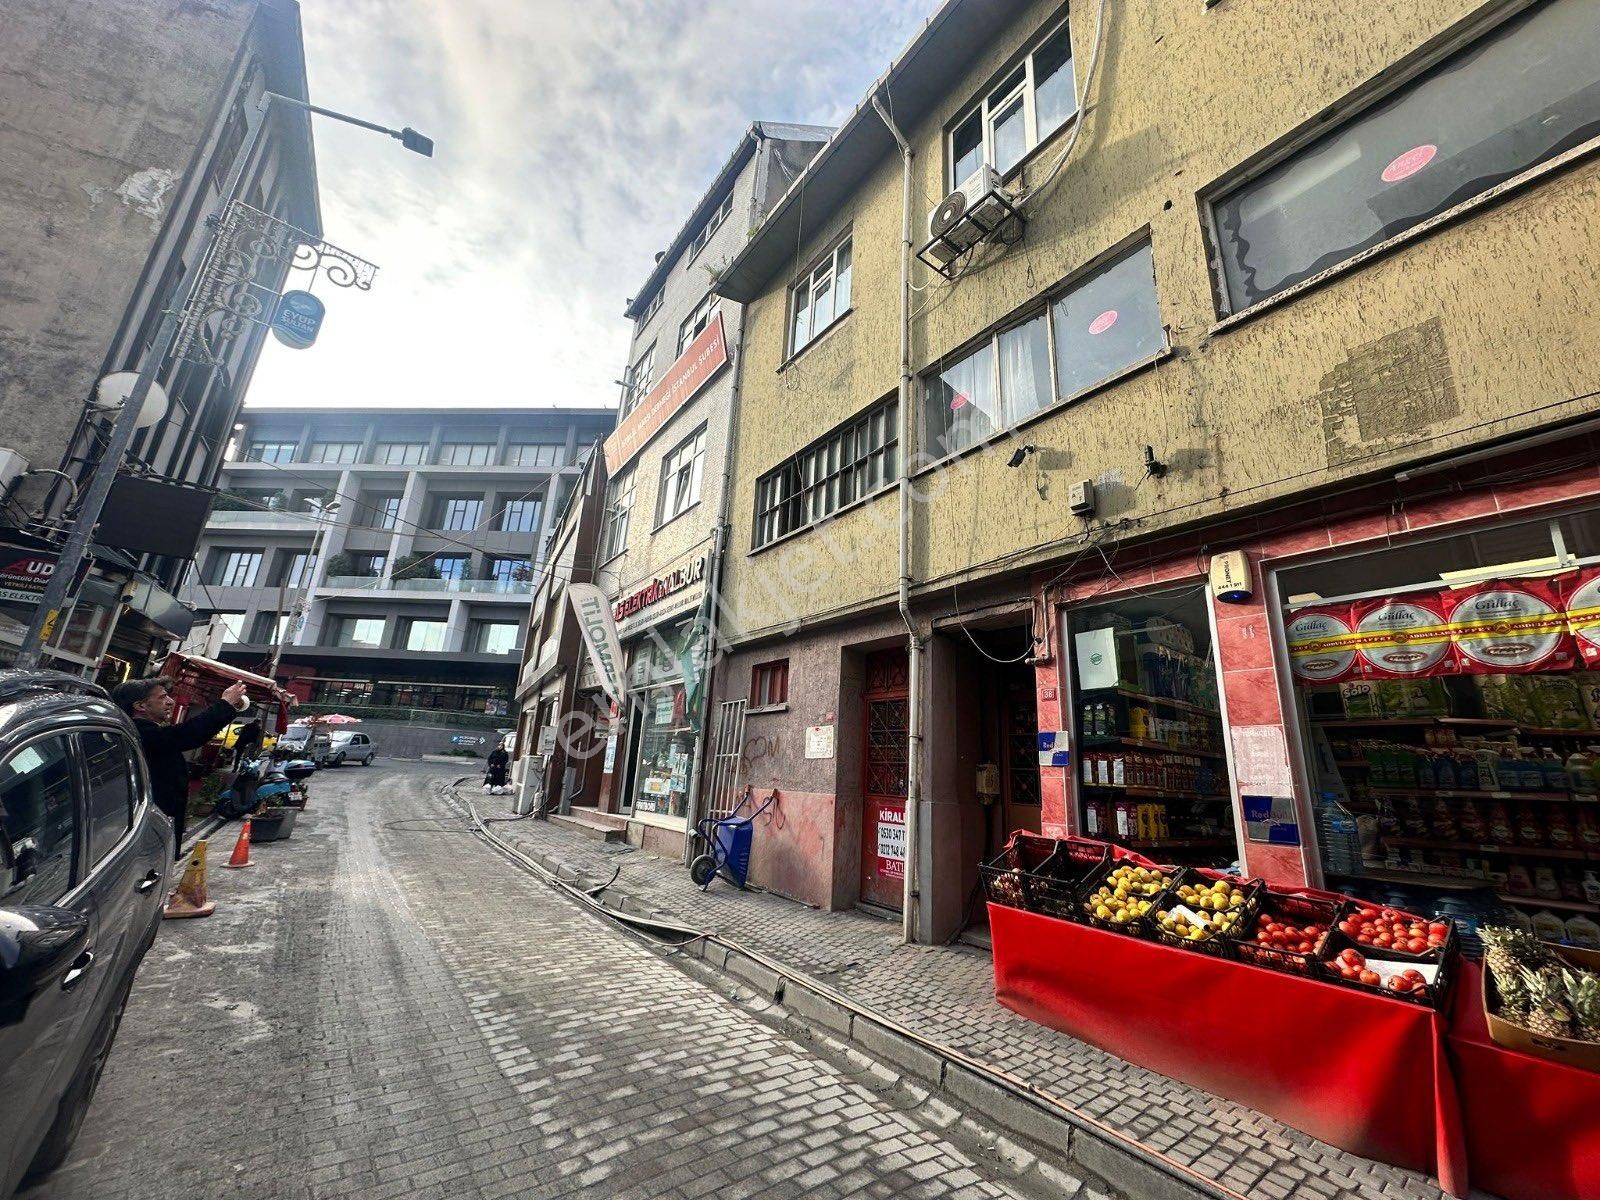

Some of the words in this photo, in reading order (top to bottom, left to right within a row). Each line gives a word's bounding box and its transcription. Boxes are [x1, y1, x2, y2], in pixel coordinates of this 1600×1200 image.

[0, 573, 32, 582] örüntülü
[9, 592, 43, 602] ELEKTR
[1343, 684, 1370, 700] Solo
